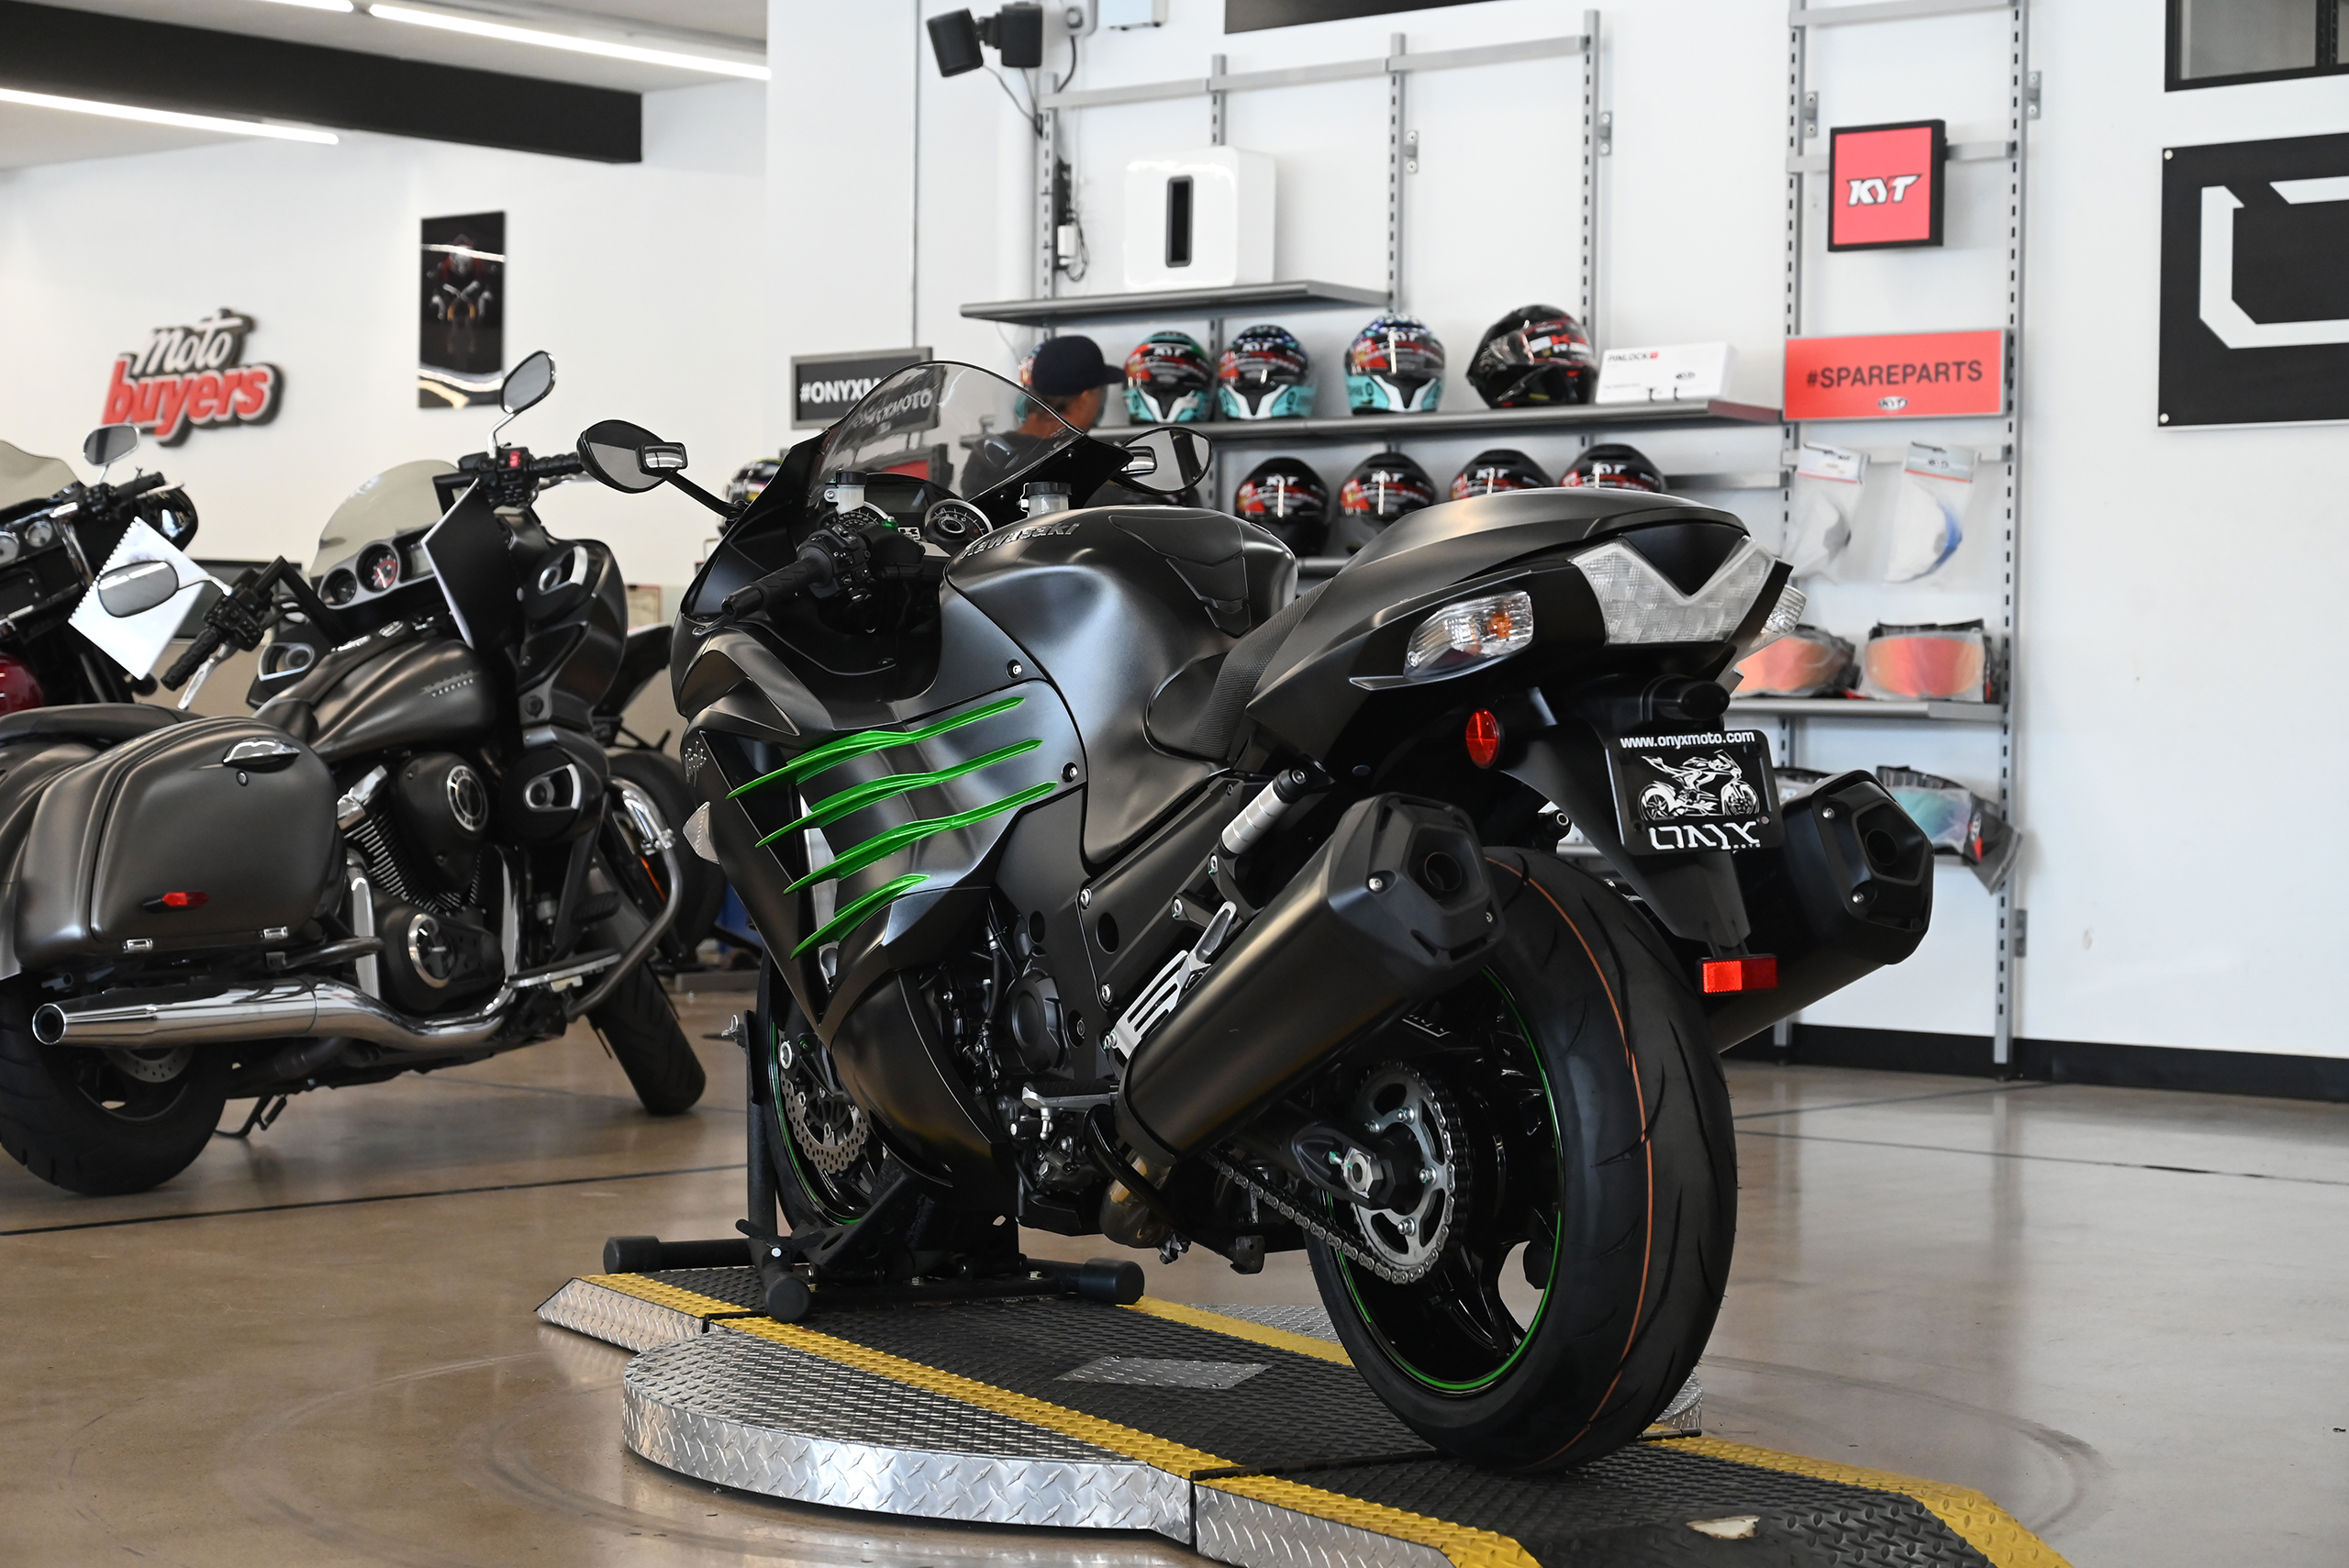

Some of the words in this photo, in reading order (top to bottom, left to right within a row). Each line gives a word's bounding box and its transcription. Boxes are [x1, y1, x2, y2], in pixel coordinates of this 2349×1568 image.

[1847, 173, 1922, 206] KYT
[1807, 361, 1983, 389] #SPAREPARTS
[101, 358, 272, 438] buyers
[1620, 731, 1755, 750] www.onyxmoto.com
